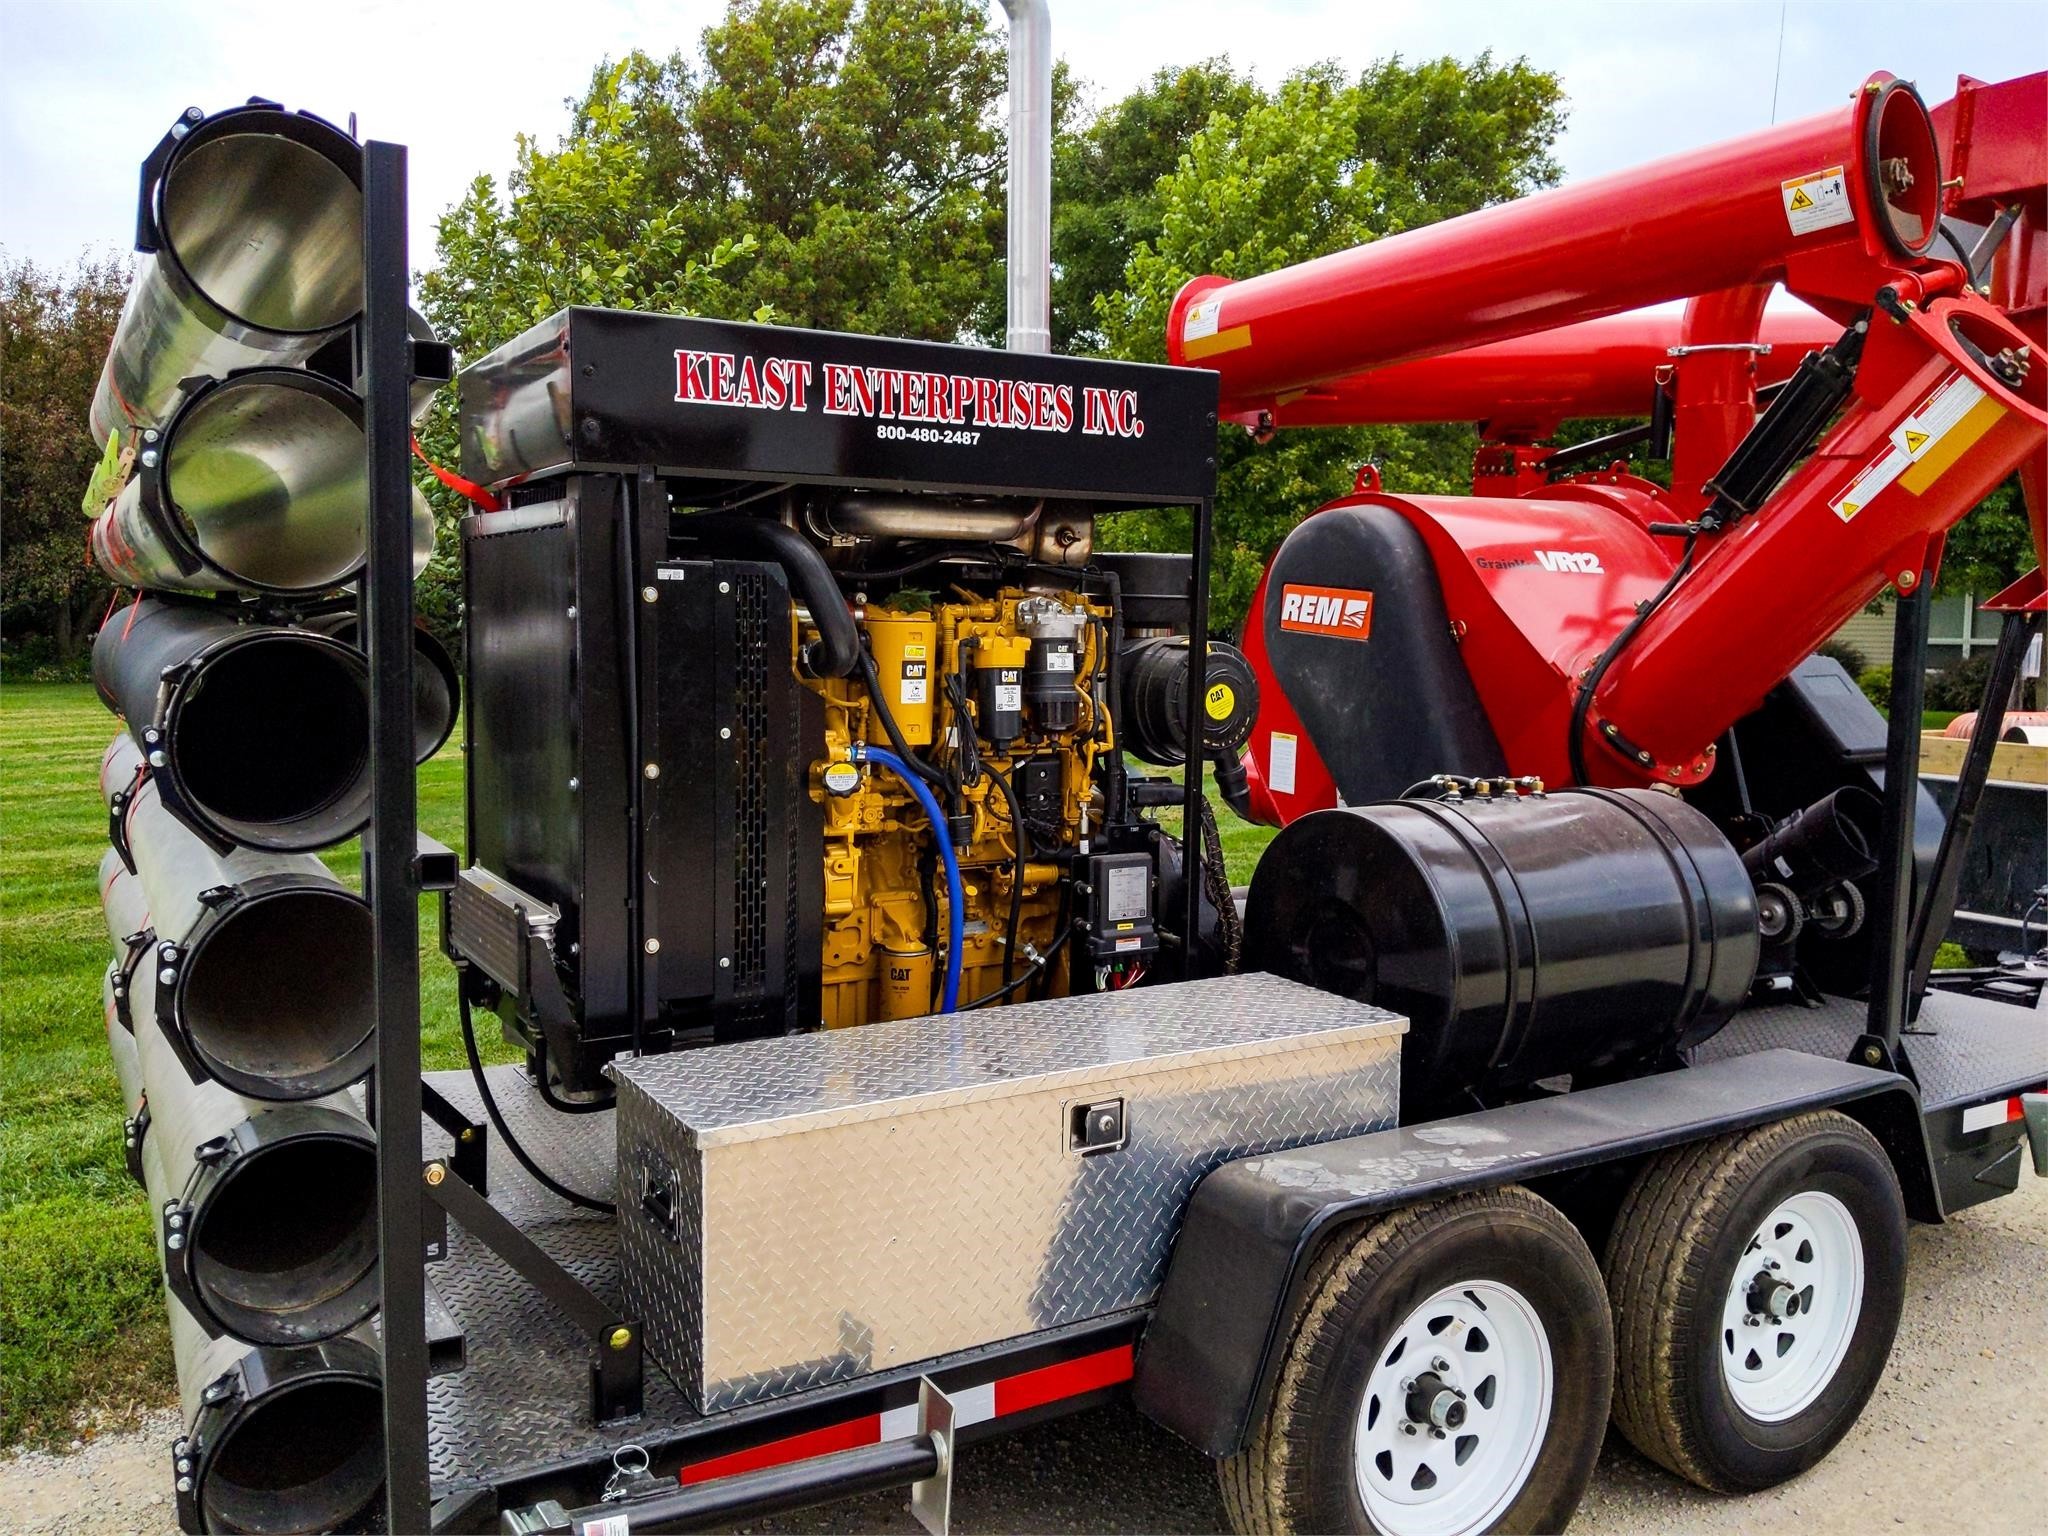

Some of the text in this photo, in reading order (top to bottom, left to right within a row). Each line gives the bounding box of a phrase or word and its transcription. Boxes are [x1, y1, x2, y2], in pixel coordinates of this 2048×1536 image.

[674, 349, 1145, 438] KEAST ENTERPRISES INC.
[877, 425, 981, 446] 800-480-2487
[1533, 550, 1605, 575] VR12
[1281, 593, 1344, 627] REM
[1057, 645, 1069, 653] CAT
[906, 664, 925, 677] CAT
[1001, 671, 1018, 683] CAT
[1210, 688, 1225, 703] CAT
[890, 968, 912, 981] CAT
